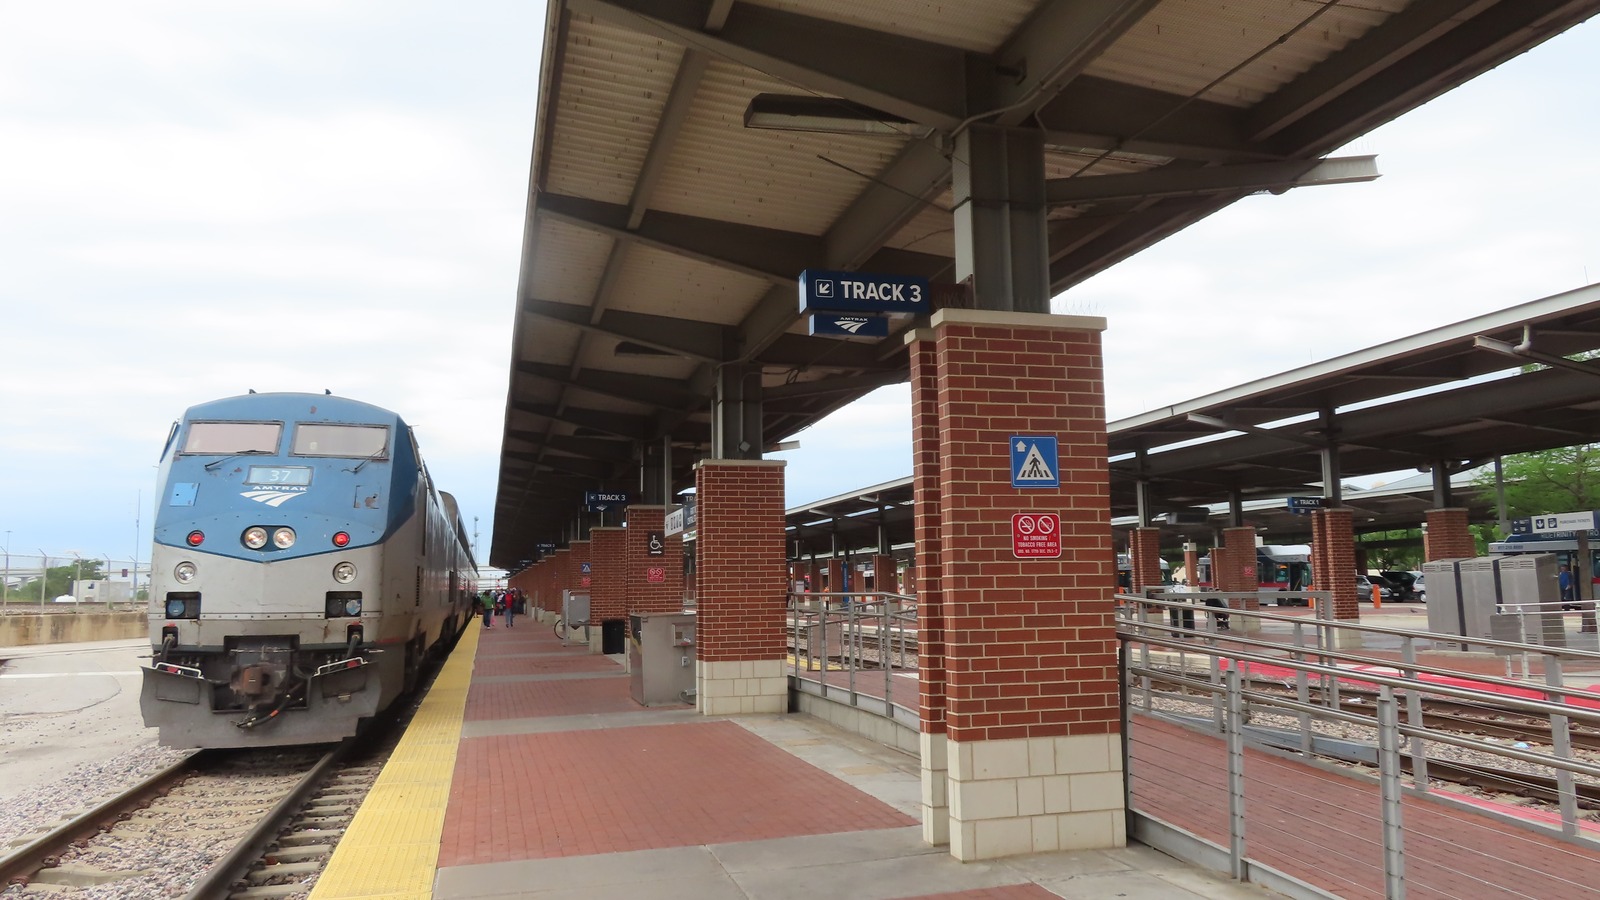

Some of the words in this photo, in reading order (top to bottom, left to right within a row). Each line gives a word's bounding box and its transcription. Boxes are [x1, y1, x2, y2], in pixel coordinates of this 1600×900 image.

[840, 280, 905, 302] TRACK
[909, 284, 922, 303] 3
[269, 470, 291, 482] 37
[621, 494, 627, 502] 3
